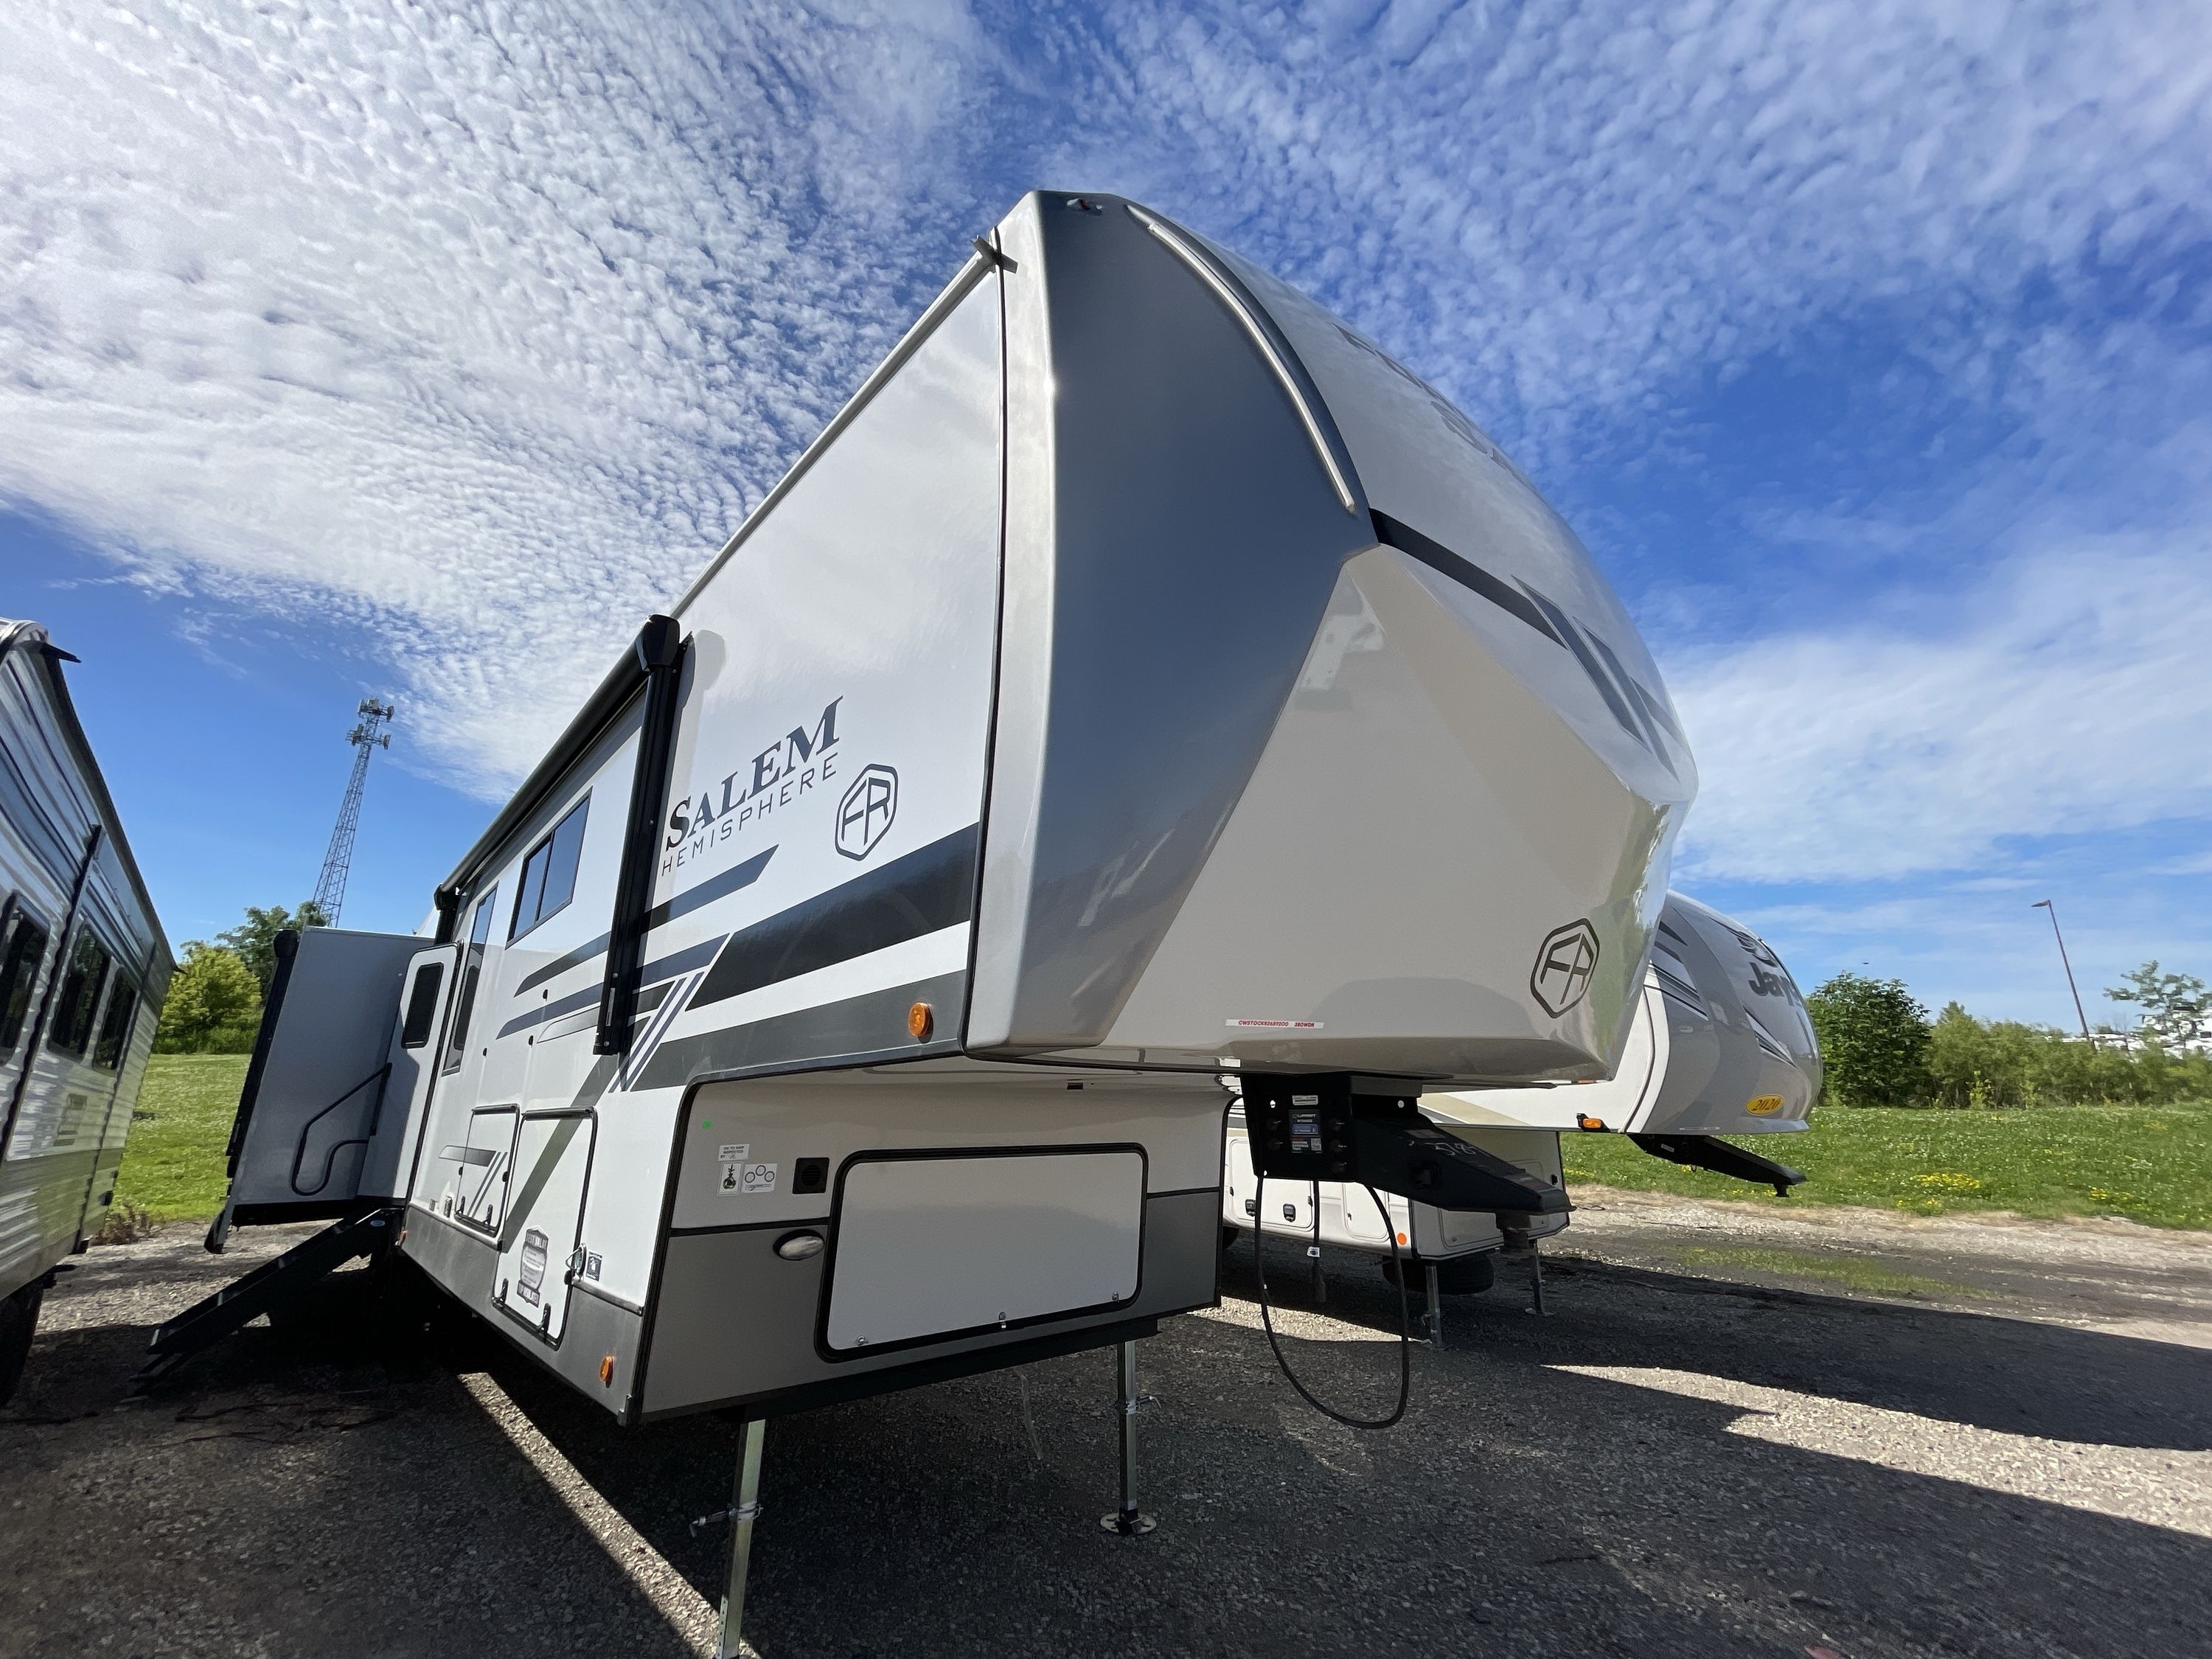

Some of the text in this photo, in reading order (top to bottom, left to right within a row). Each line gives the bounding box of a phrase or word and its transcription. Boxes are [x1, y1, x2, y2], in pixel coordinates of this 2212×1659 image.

[661, 751, 838, 877] HEMISPHERE
[665, 695, 844, 852] SALEM
[1751, 1097, 1781, 1112] 2020
